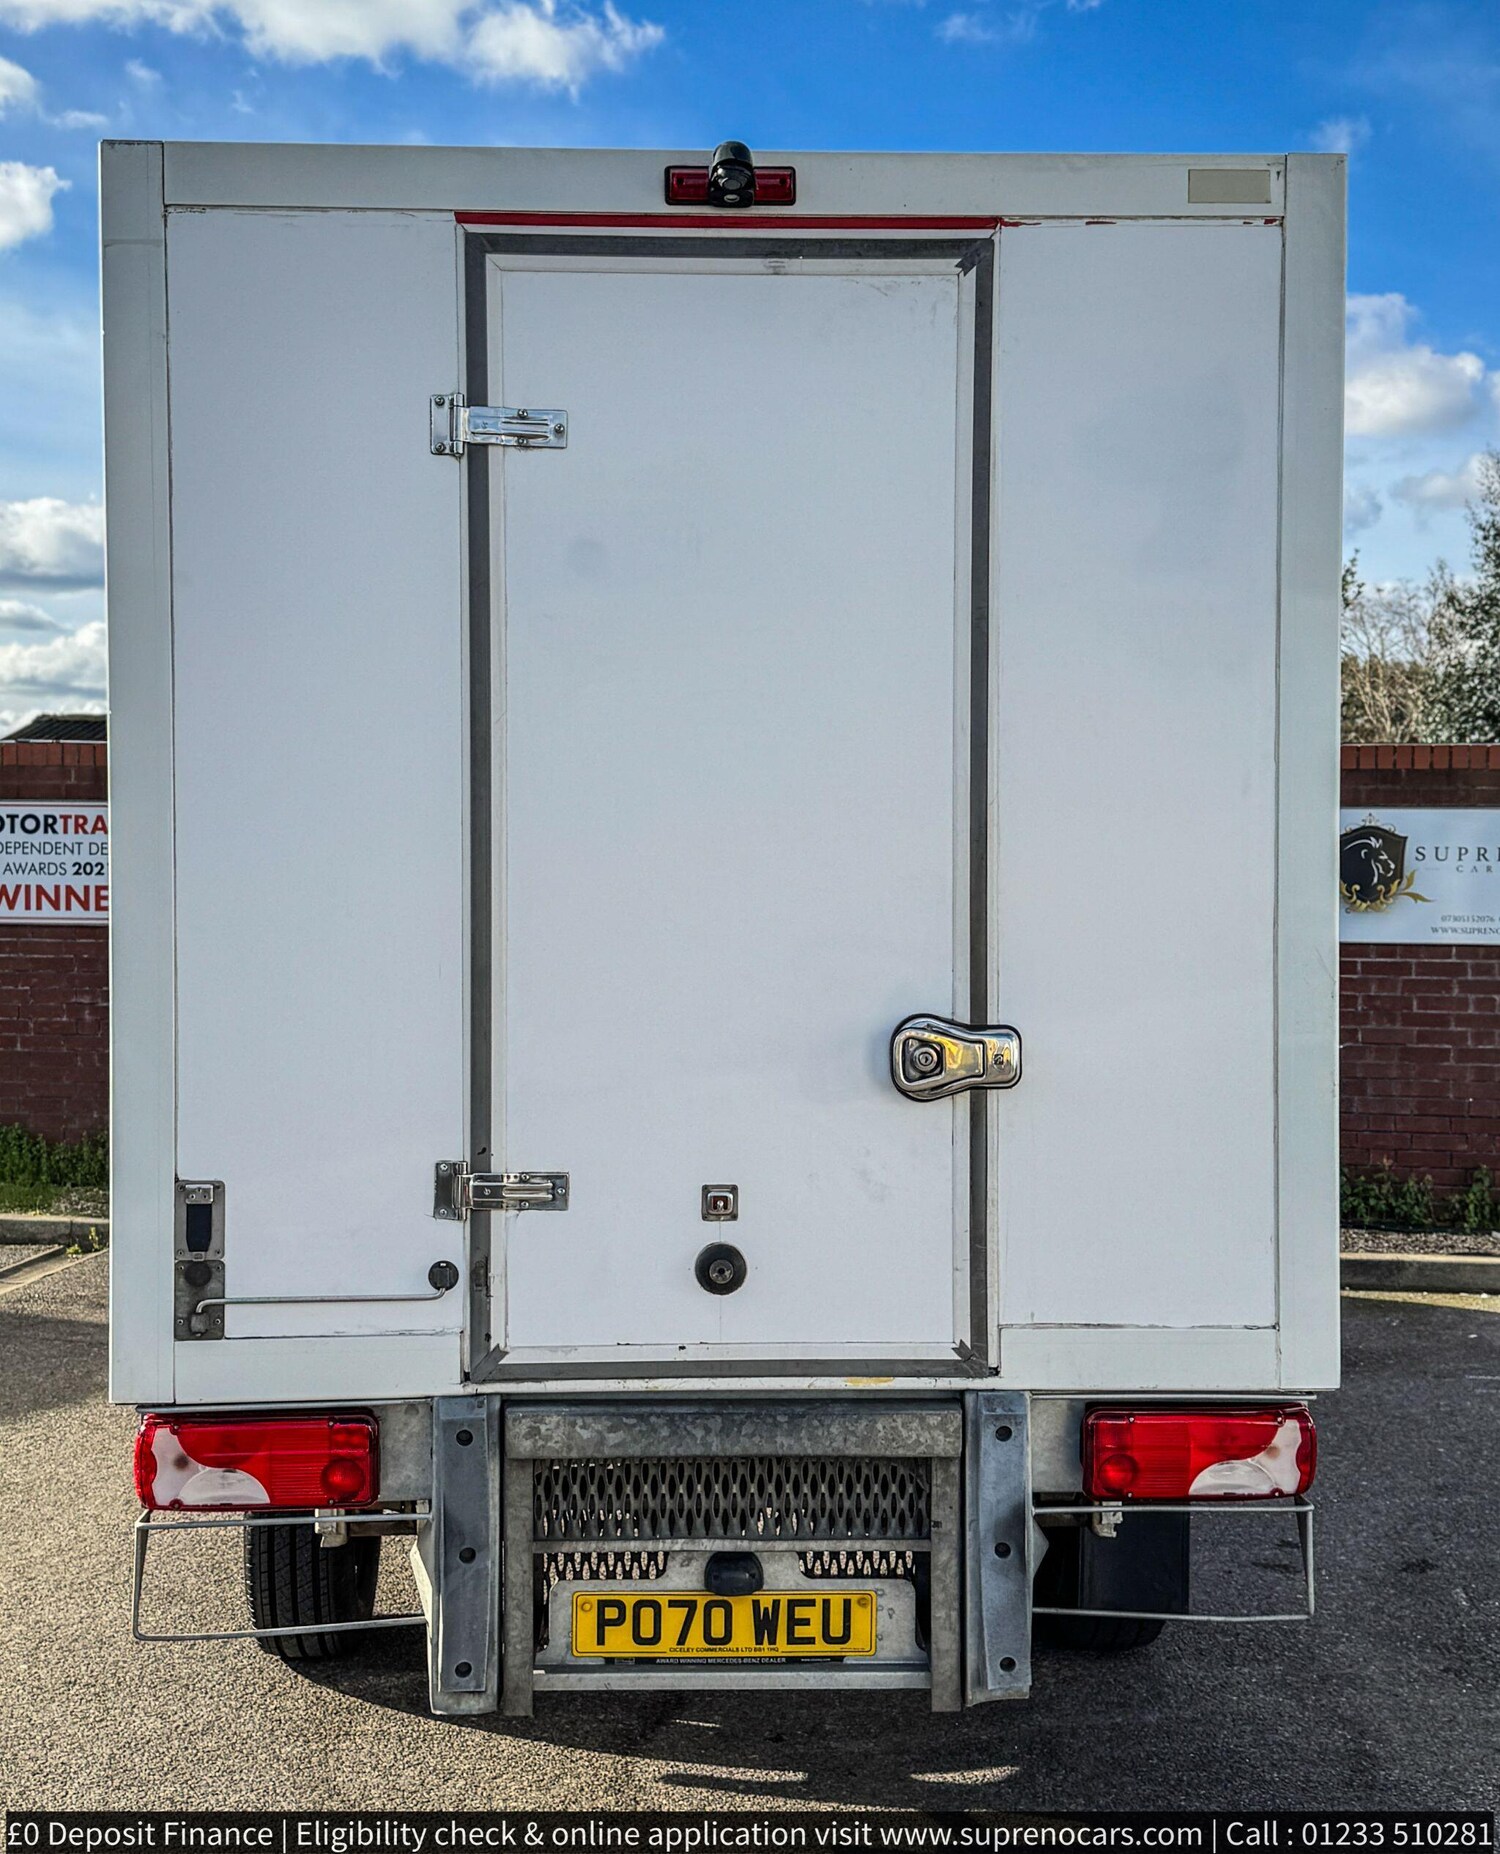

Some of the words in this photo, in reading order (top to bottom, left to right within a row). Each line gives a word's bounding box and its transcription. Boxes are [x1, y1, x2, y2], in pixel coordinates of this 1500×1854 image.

[0, 814, 108, 835] TORTRA
[1415, 846, 1500, 862] SUPR
[3, 862, 67, 875] AWARDS
[72, 862, 108, 876] 202
[596, 1599, 733, 1646] PO70
[752, 1599, 852, 1646] WEU
